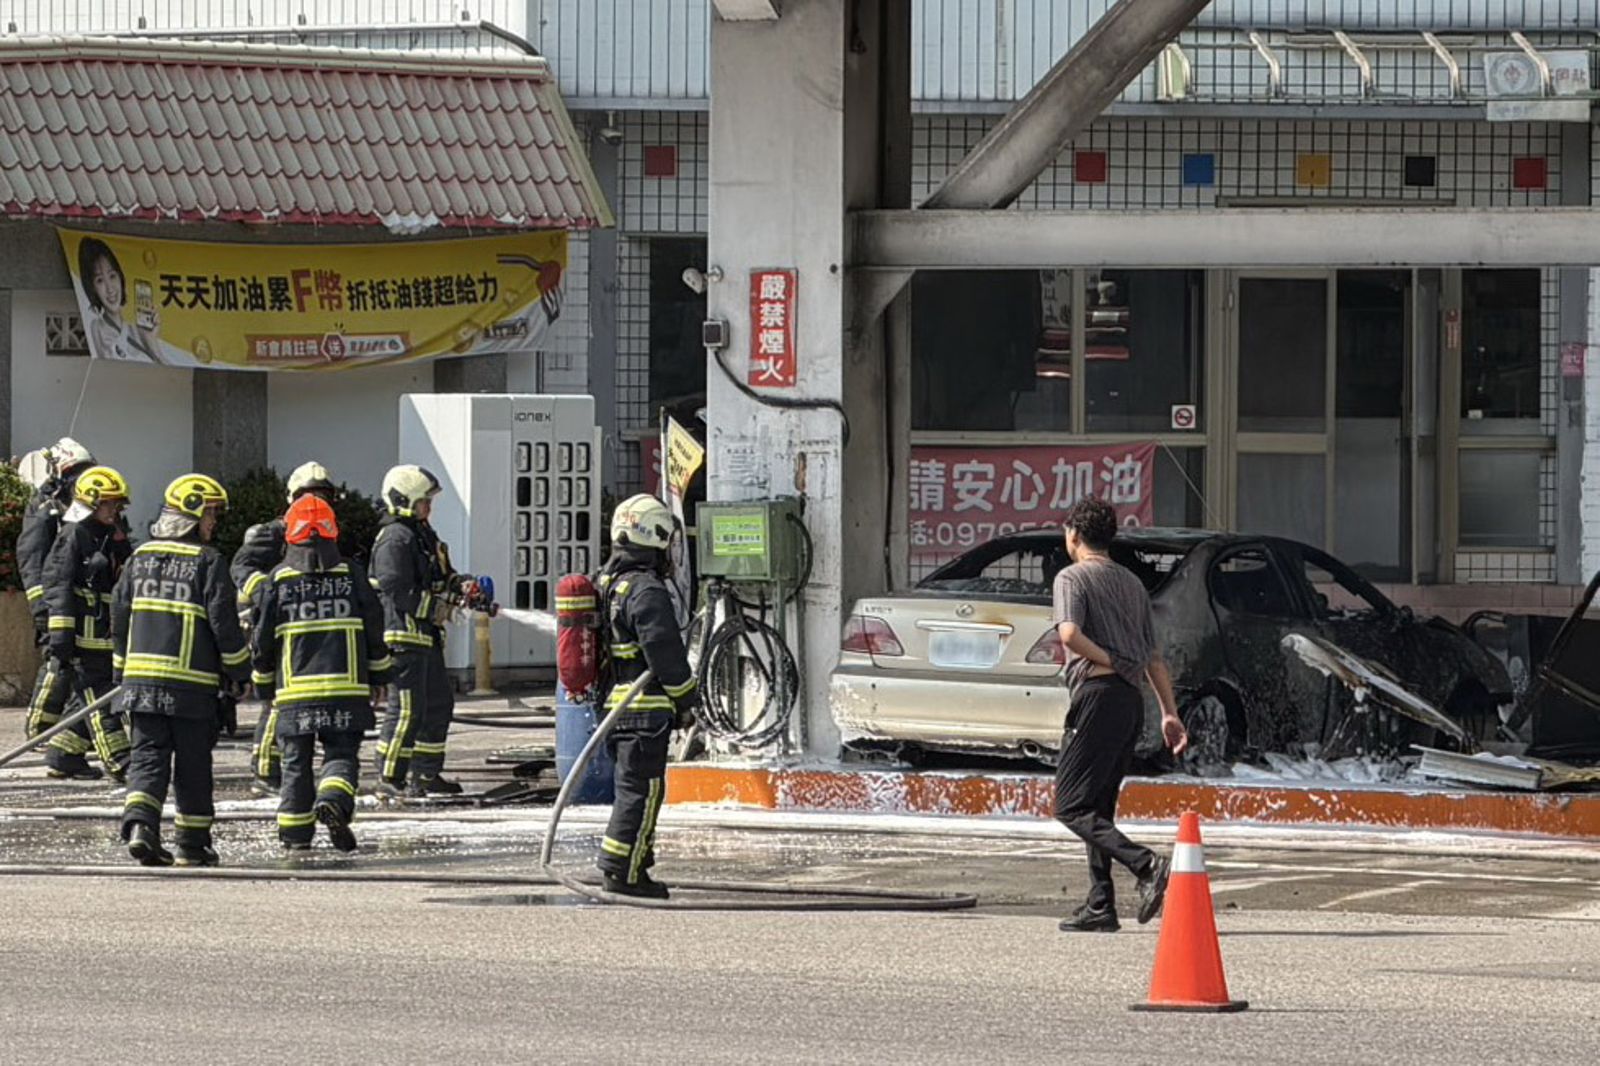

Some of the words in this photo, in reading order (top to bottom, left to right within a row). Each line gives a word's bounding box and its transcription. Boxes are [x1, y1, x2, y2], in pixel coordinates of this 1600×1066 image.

[758, 274, 786, 381] 嚴禁煙火
[910, 454, 1142, 512] 請安心加油
[281, 598, 351, 622] TCFD
